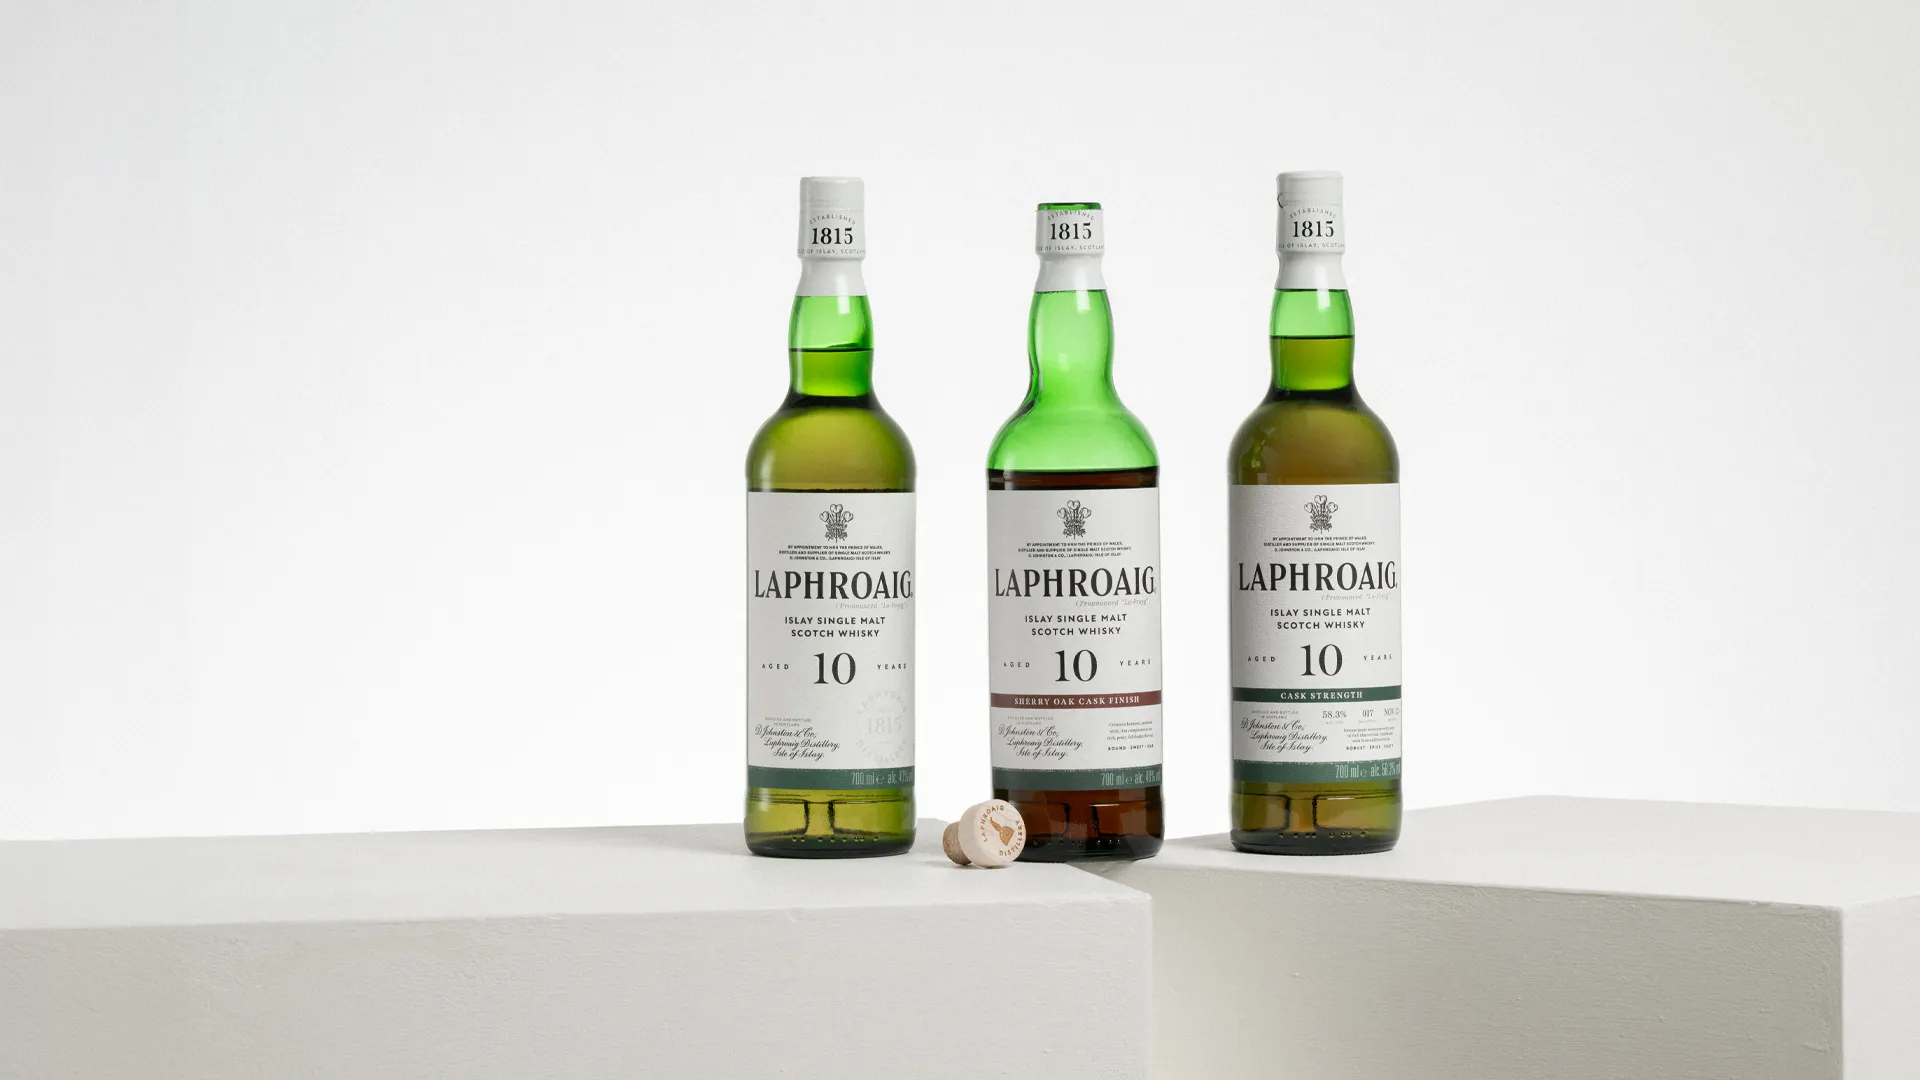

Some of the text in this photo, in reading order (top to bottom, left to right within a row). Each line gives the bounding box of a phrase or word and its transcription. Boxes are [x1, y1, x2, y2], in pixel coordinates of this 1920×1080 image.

[809, 214, 856, 225] ESTABLISHED
[1048, 210, 1095, 221] ESTABLISHED
[1290, 207, 1337, 219] ESTABLISHED
[811, 227, 853, 245] 1815
[1050, 222, 1092, 240] 1815
[1292, 220, 1334, 238] 1815
[995, 566, 1154, 597] LAPHROAIG
[1239, 560, 1396, 591] LAPHROAIG
[754, 570, 911, 600] LAPHROAIG
[1025, 613, 1127, 623] ISLAY SINGLE MALT
[1270, 607, 1371, 617] ISLAY SINGLE MALT
[785, 616, 885, 625] ISLAY SINGLE MALT
[1277, 621, 1365, 630] SCOTCH WHISKY
[791, 629, 880, 638] SCOTCH WHISKY
[1031, 627, 1121, 636] SCOTCH WHISKY
[1055, 649, 1098, 682] 10
[1120, 659, 1151, 667] YEARS
[1300, 644, 1343, 676] 10
[813, 652, 856, 685] 10
[1014, 697, 1050, 706] SHERRY
[1079, 697, 1105, 705] CASK
[1109, 696, 1140, 704] FINISH
[1280, 691, 1363, 700] CASK STRENGTH
[1322, 710, 1347, 719] 58.3%
[1362, 709, 1374, 718] 017
[867, 716, 902, 735] 1815
[1036, 728, 1045, 736] &
[763, 737, 800, 751] Laphroaig
[1006, 736, 1042, 750] Laphroaig
[1250, 730, 1287, 744] Laphroaig
[773, 746, 788, 758] Isle
[788, 750, 800, 760] of
[1016, 746, 1031, 757] Isle
[1031, 749, 1042, 760] of
[1260, 740, 1274, 750] Isle
[1276, 742, 1287, 753] of
[851, 772, 864, 785] 700
[866, 772, 875, 785] ml
[1335, 764, 1349, 779] 700
[1350, 764, 1359, 778] ml
[1101, 772, 1114, 786] 700
[1116, 772, 1124, 785] ml
[980, 805, 1004, 842] LAPHROAIG
[999, 820, 1023, 856] DISTILLERY
